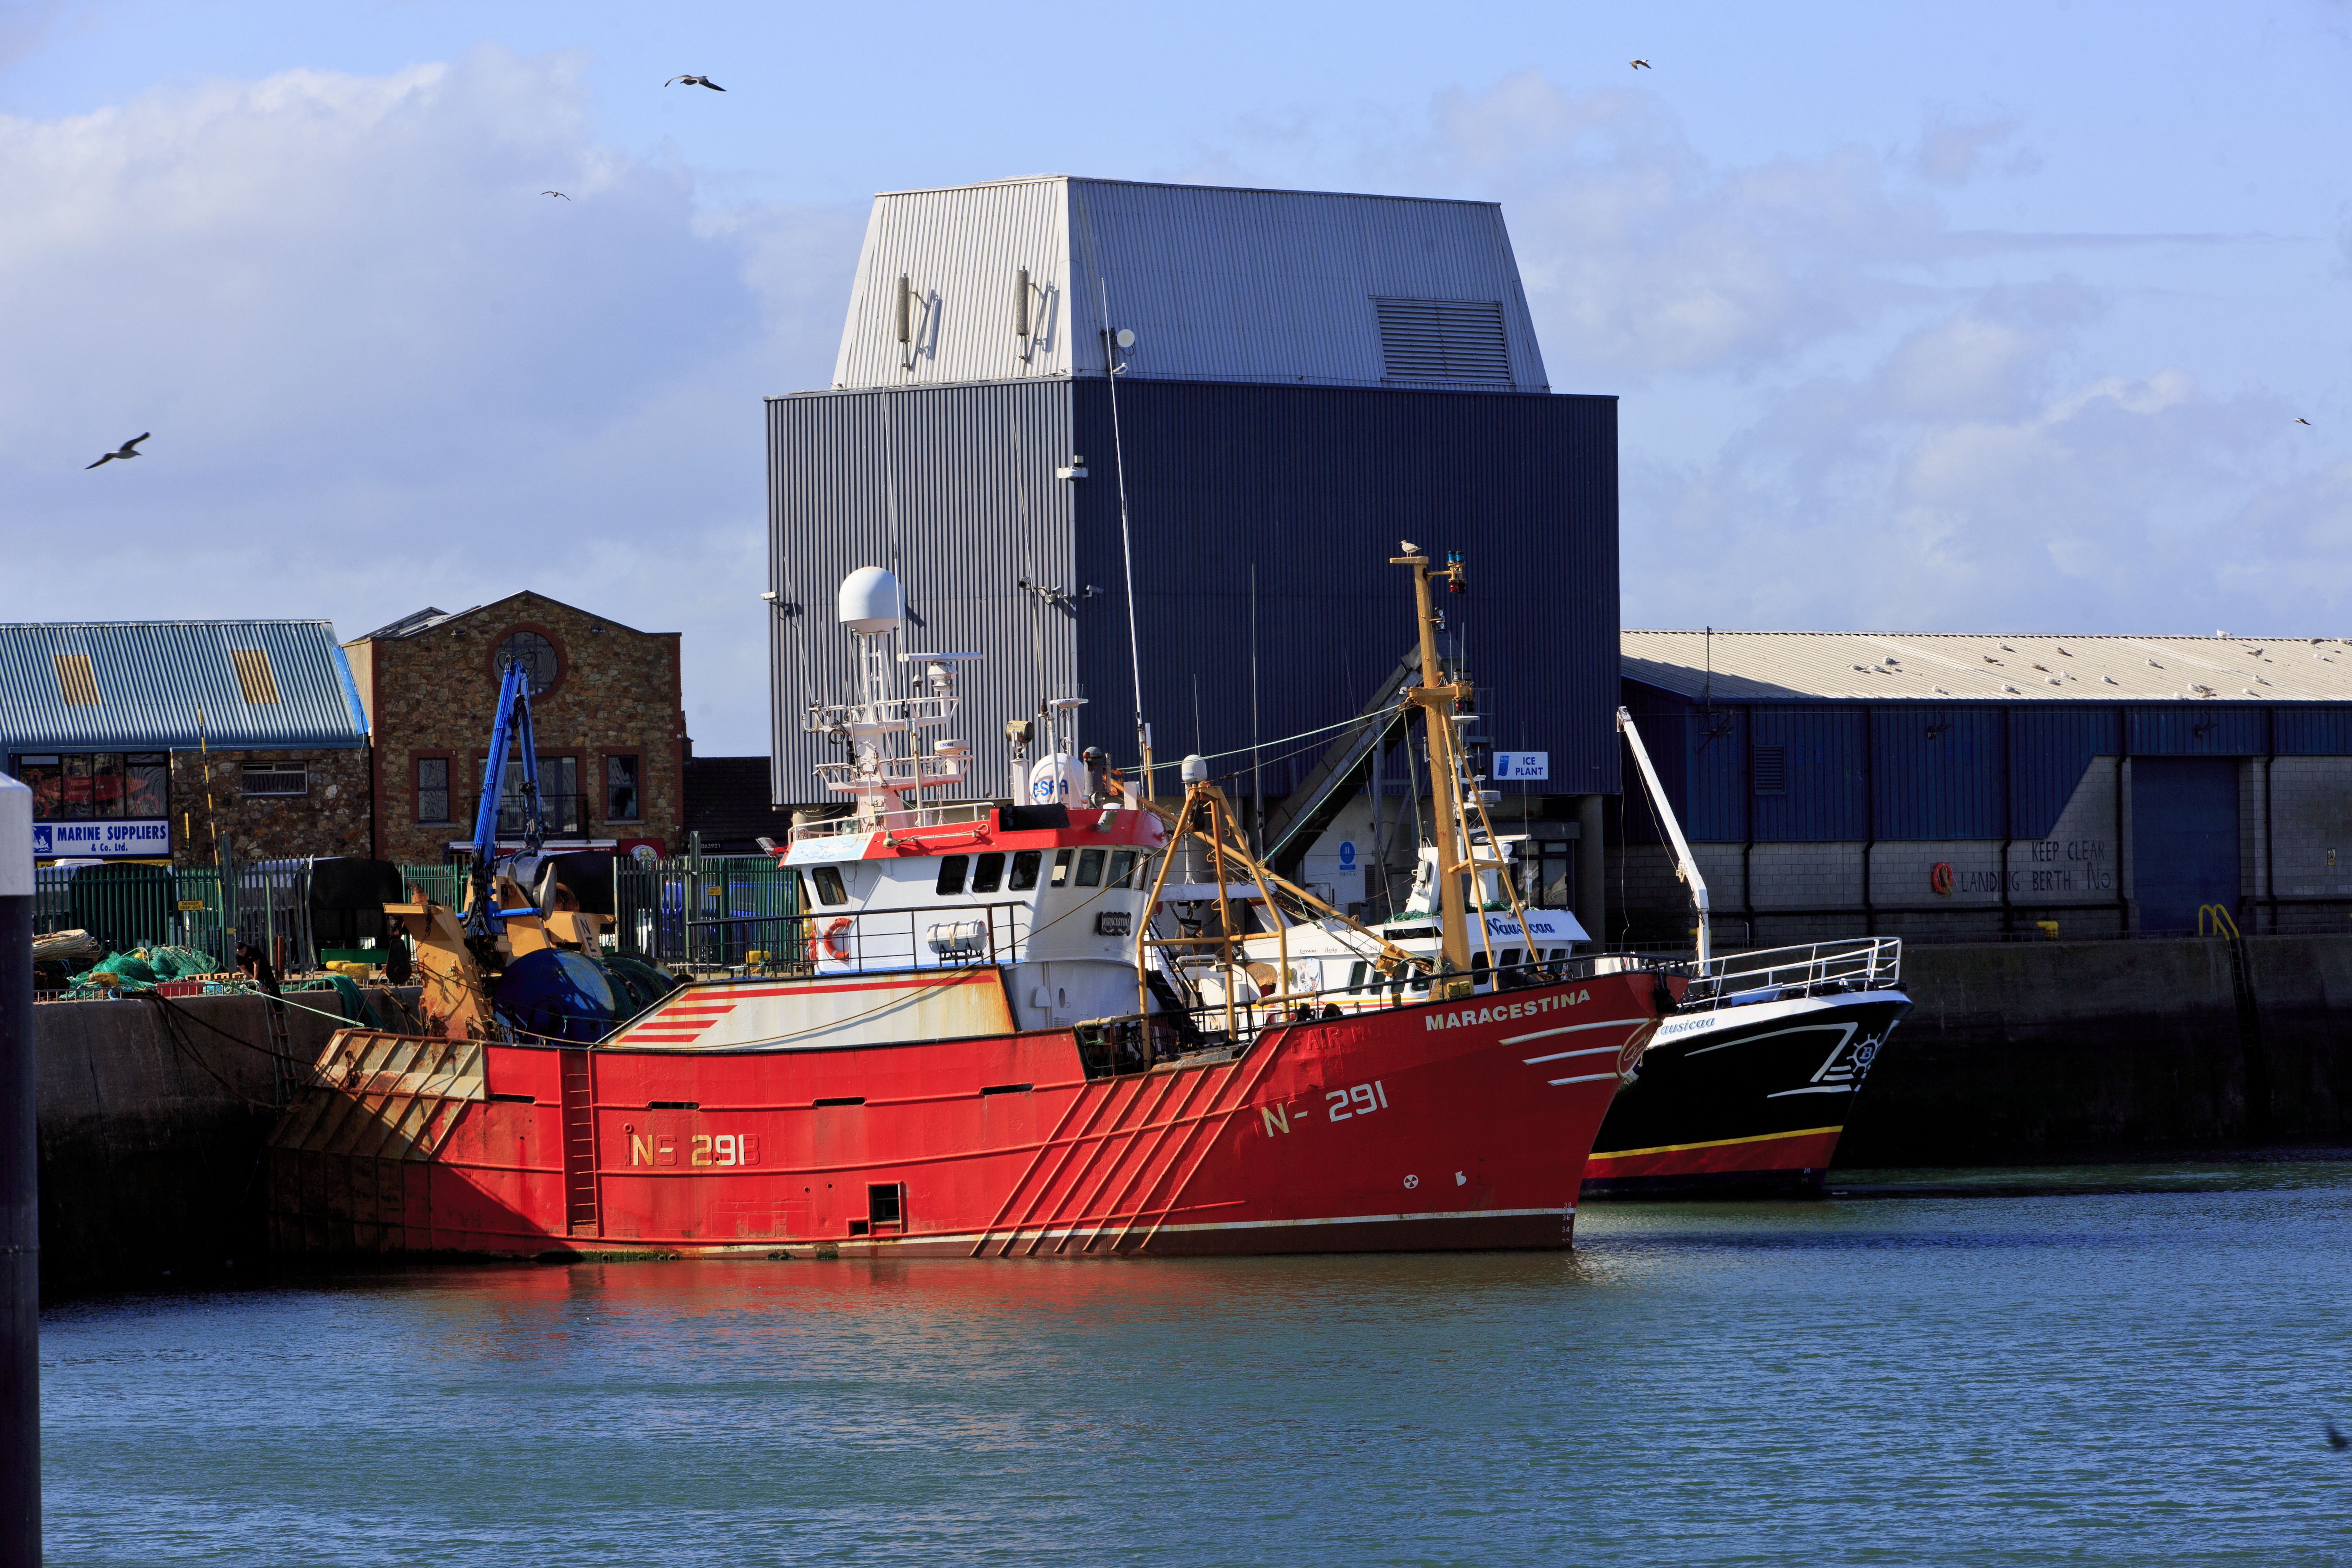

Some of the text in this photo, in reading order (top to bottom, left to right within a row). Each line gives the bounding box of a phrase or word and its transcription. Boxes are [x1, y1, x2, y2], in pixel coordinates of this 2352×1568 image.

[1523, 757, 1535, 765] ICE
[1516, 767, 1543, 776] PLANT
[57, 825, 166, 841] MARINE SUPPLIERS
[91, 842, 128, 852] & Co. Ltd.
[2032, 841, 2105, 861] KEEP CLEAR
[2032, 871, 2071, 891] BERTH
[2087, 861, 2111, 889] No
[1486, 918, 1555, 936] Nauscaa
[579, 919, 598, 957] NE
[1425, 989, 1591, 1031] MARACESTINA
[1656, 1017, 1716, 1037] ausicaa
[1859, 1046, 1873, 1061] B
[1325, 1080, 1388, 1122] 291
